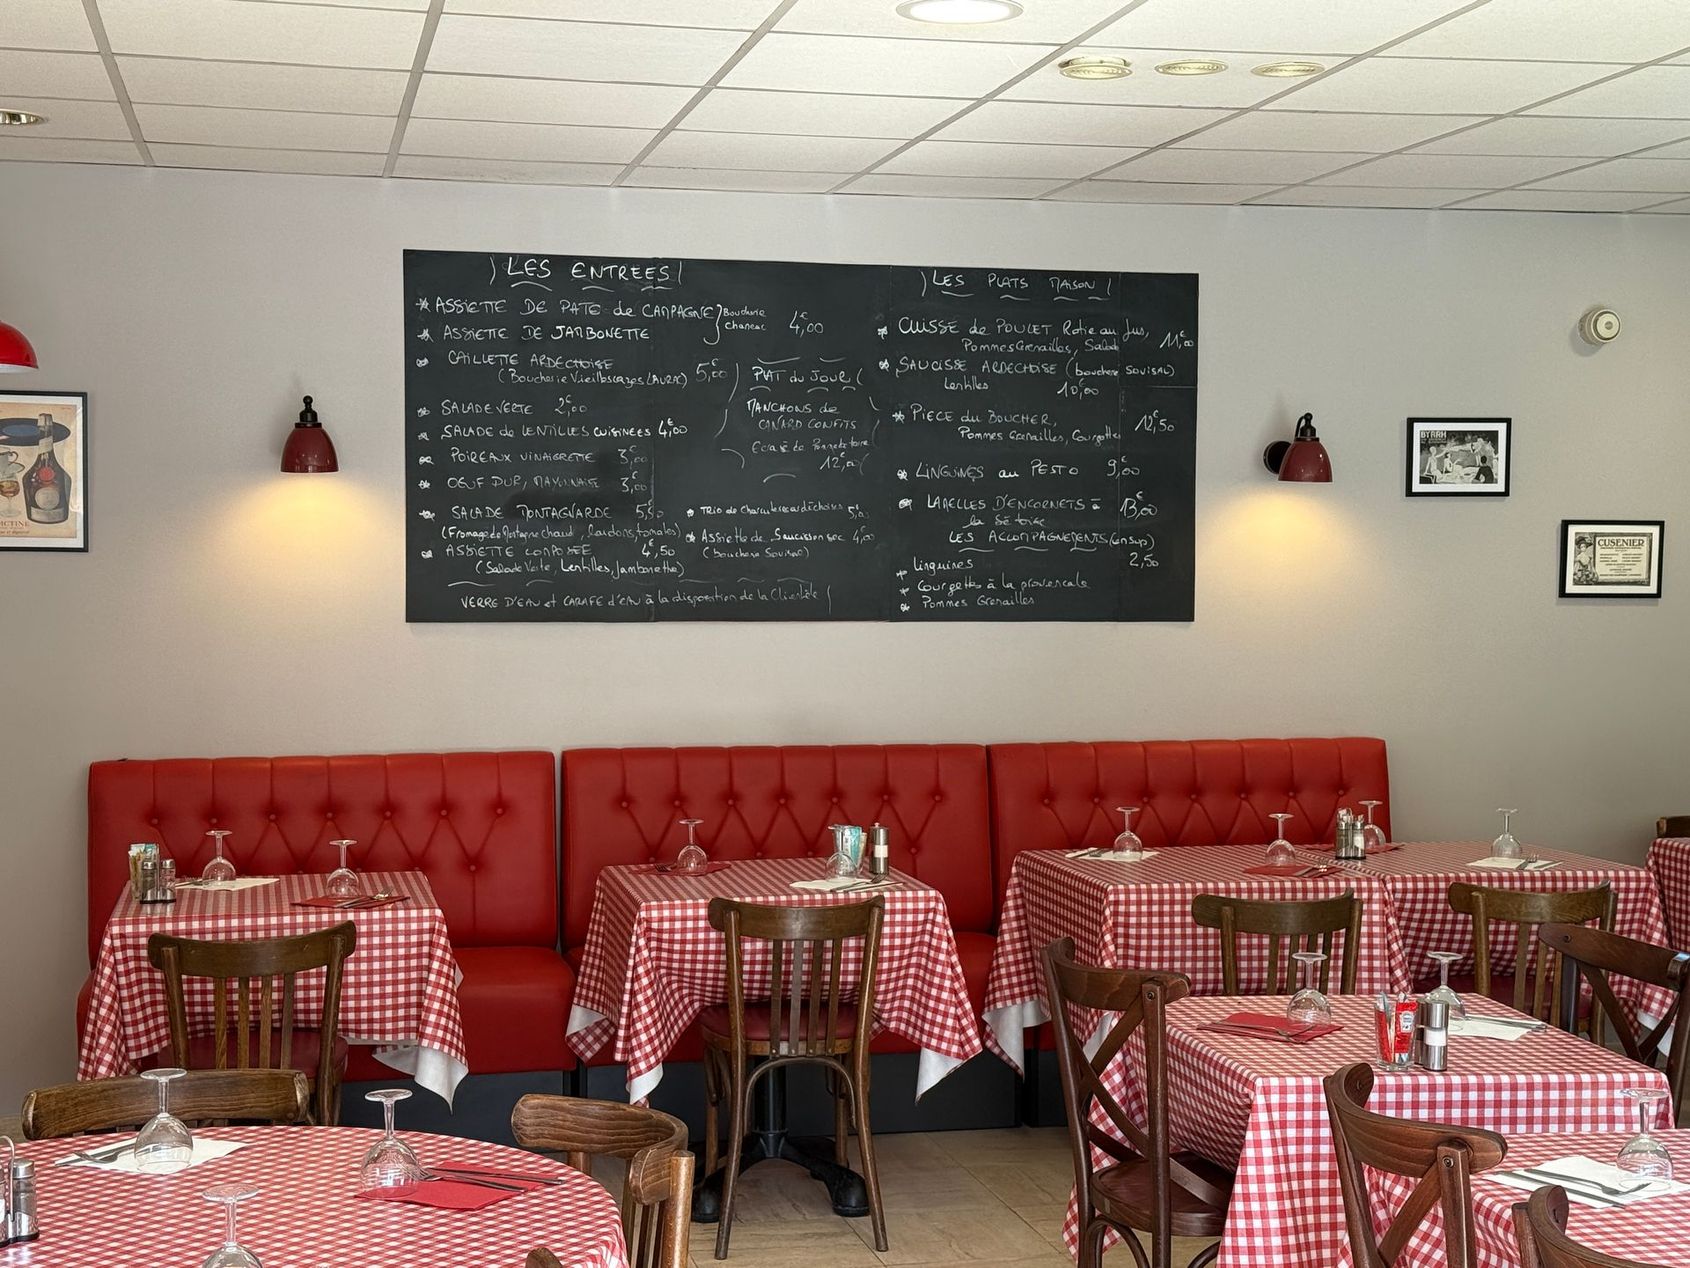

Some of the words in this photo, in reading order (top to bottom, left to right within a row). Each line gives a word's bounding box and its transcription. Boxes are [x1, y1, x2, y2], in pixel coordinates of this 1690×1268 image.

[507, 256, 551, 278] LES
[571, 261, 670, 282] ENTREES
[932, 269, 965, 287] LES
[988, 272, 1029, 289] PLATS
[1049, 276, 1096, 293] MAISON
[436, 297, 507, 314] ASSIETTE
[520, 299, 547, 315] DE
[560, 300, 601, 316] PATE
[613, 301, 633, 317] de
[642, 303, 714, 320] CAMPAGNE
[443, 325, 509, 341] ASSIETTE
[521, 326, 543, 341] DE
[550, 325, 650, 341] JAMBONETTE
[898, 316, 960, 335] CUISSE
[969, 318, 991, 336] de
[996, 318, 1052, 335] POULET
[1100, 326, 1119, 335] au
[962, 338, 1014, 352] Pommes
[530, 354, 615, 370] ARDECHOISE
[896, 356, 967, 378] SAUCISSE
[981, 360, 1057, 374] ARDECHOISE
[751, 366, 787, 382] PLAT
[789, 370, 805, 383] du
[810, 370, 851, 383] JOUR
[441, 399, 491, 415] SALADE
[495, 400, 534, 415] VERTE
[747, 398, 812, 418] MANCHONS
[820, 402, 840, 414] de
[910, 403, 953, 422] PIECE
[961, 410, 981, 422] du
[441, 425, 493, 440] SALADE
[500, 424, 514, 437] de
[522, 424, 589, 437] LENTILLES
[808, 418, 856, 430] CONFITS
[958, 426, 1003, 441] Pommes
[451, 447, 512, 463] POIREAUX
[999, 469, 1019, 478] au
[1031, 459, 1079, 477] PESTO
[451, 505, 504, 520] SALADE
[962, 515, 985, 528] la
[949, 531, 974, 543] LES
[1598, 538, 1645, 547] CUSENIER
[1002, 572, 1017, 590] la
[461, 595, 499, 608] VERRE
[544, 593, 556, 608] et
[563, 595, 604, 607] CARAFE
[657, 589, 670, 604] la
[739, 589, 753, 601] de
[757, 589, 768, 601] la
[922, 595, 968, 609] Pommes
